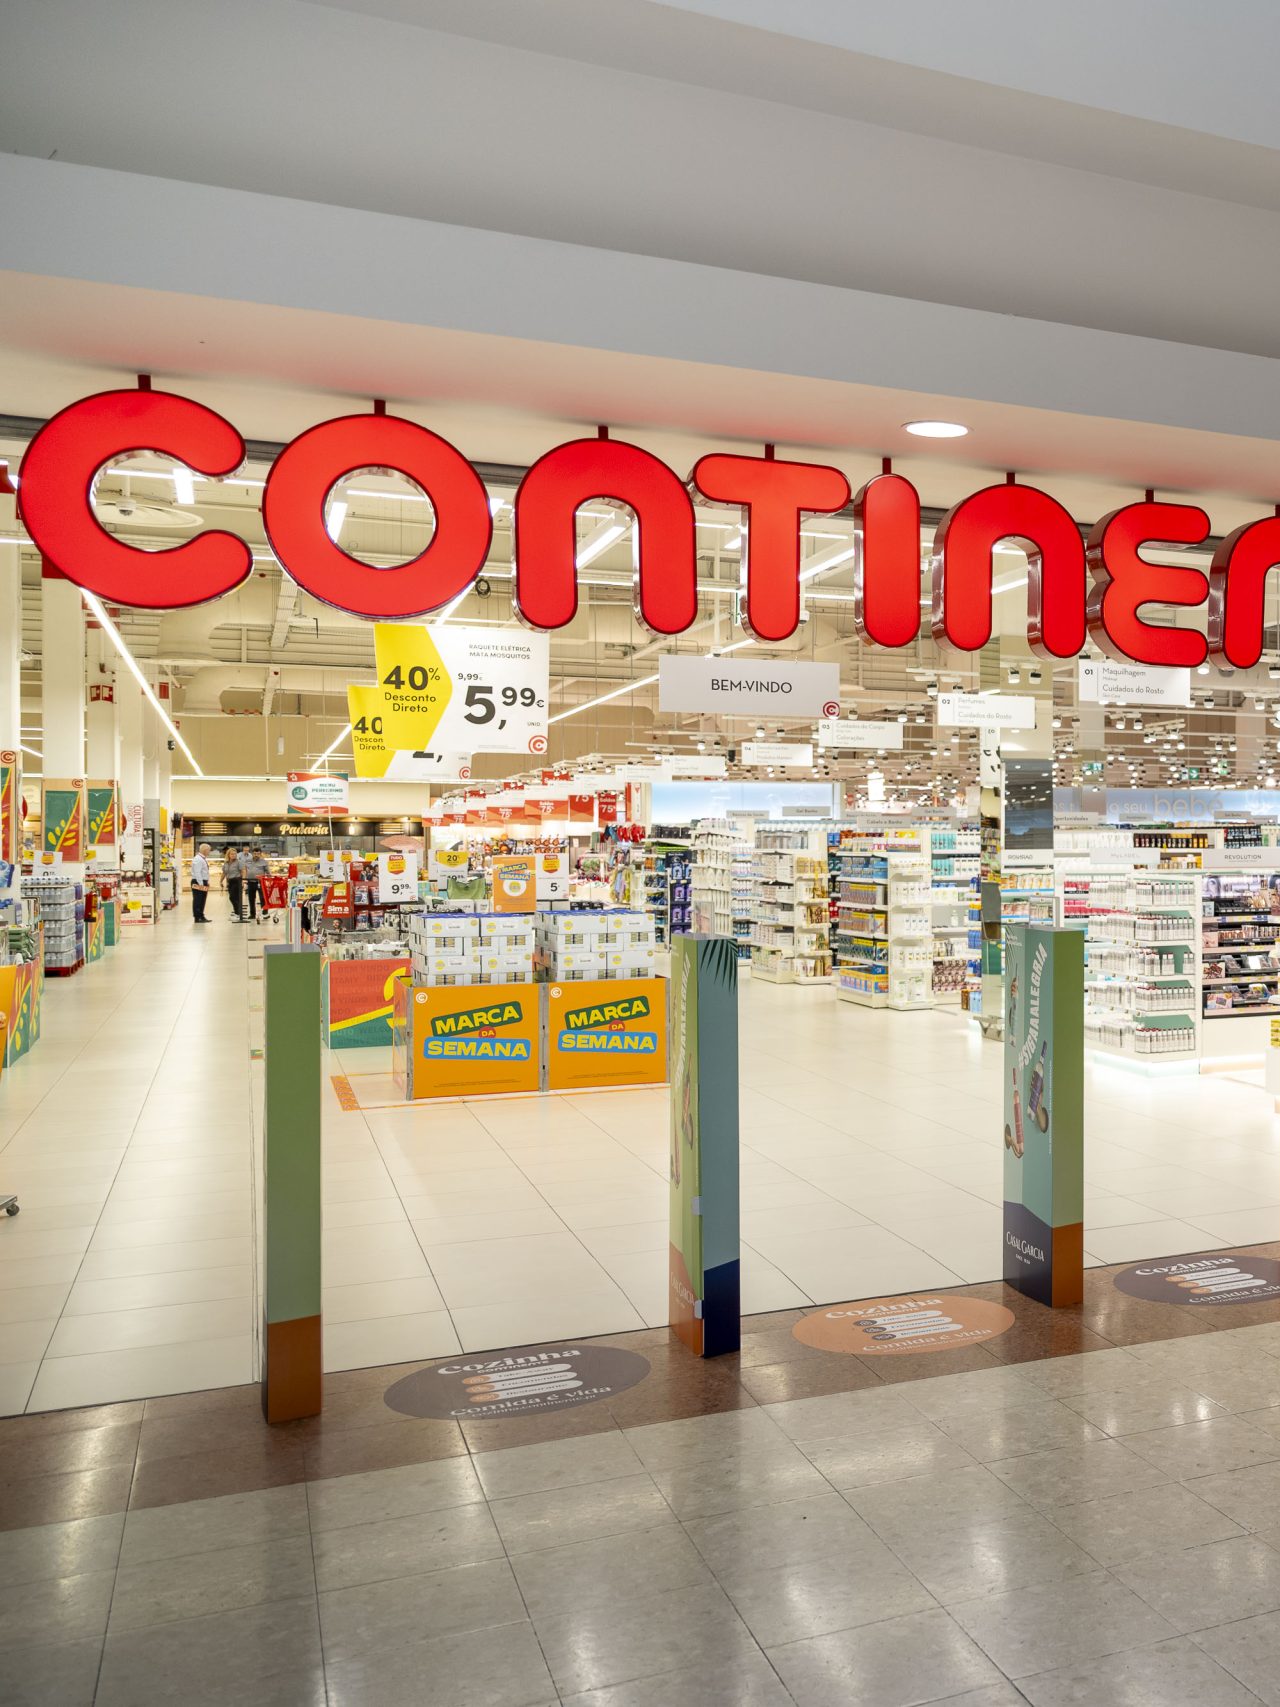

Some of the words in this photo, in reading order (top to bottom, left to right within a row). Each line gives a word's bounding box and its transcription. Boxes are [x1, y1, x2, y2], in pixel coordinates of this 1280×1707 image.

[490, 652, 531, 660] MOSQUITOS
[500, 645, 531, 653] ELÉTRICA
[383, 665, 441, 691] 40%
[1102, 667, 1146, 677] Maquilhagem
[711, 678, 793, 694] BEM-VINDO
[1102, 684, 1135, 693] Cuidados
[1135, 685, 1144, 693] do
[1145, 686, 1165, 695] Rosto
[384, 692, 437, 703] Desconto
[392, 702, 428, 713] Direto
[279, 824, 329, 835] Padaria
[435, 1005, 520, 1035] MARCA
[568, 1000, 647, 1028] MARCA
[481, 1029, 495, 1037] DA
[611, 1023, 624, 1031] DA
[427, 1040, 528, 1057] SEMANA
[561, 1034, 656, 1050] SEMANA
[1021, 1240, 1045, 1262] GARCIA
[1135, 1257, 1235, 1276] Cozinha
[1188, 1290, 1251, 1303] Comida
[825, 1297, 944, 1319] Cozinha
[862, 1335, 936, 1351] Comida
[957, 1327, 993, 1338] vida
[437, 1349, 581, 1375] Cozinha
[449, 1397, 541, 1416] Comida
[568, 1385, 612, 1398] vida
